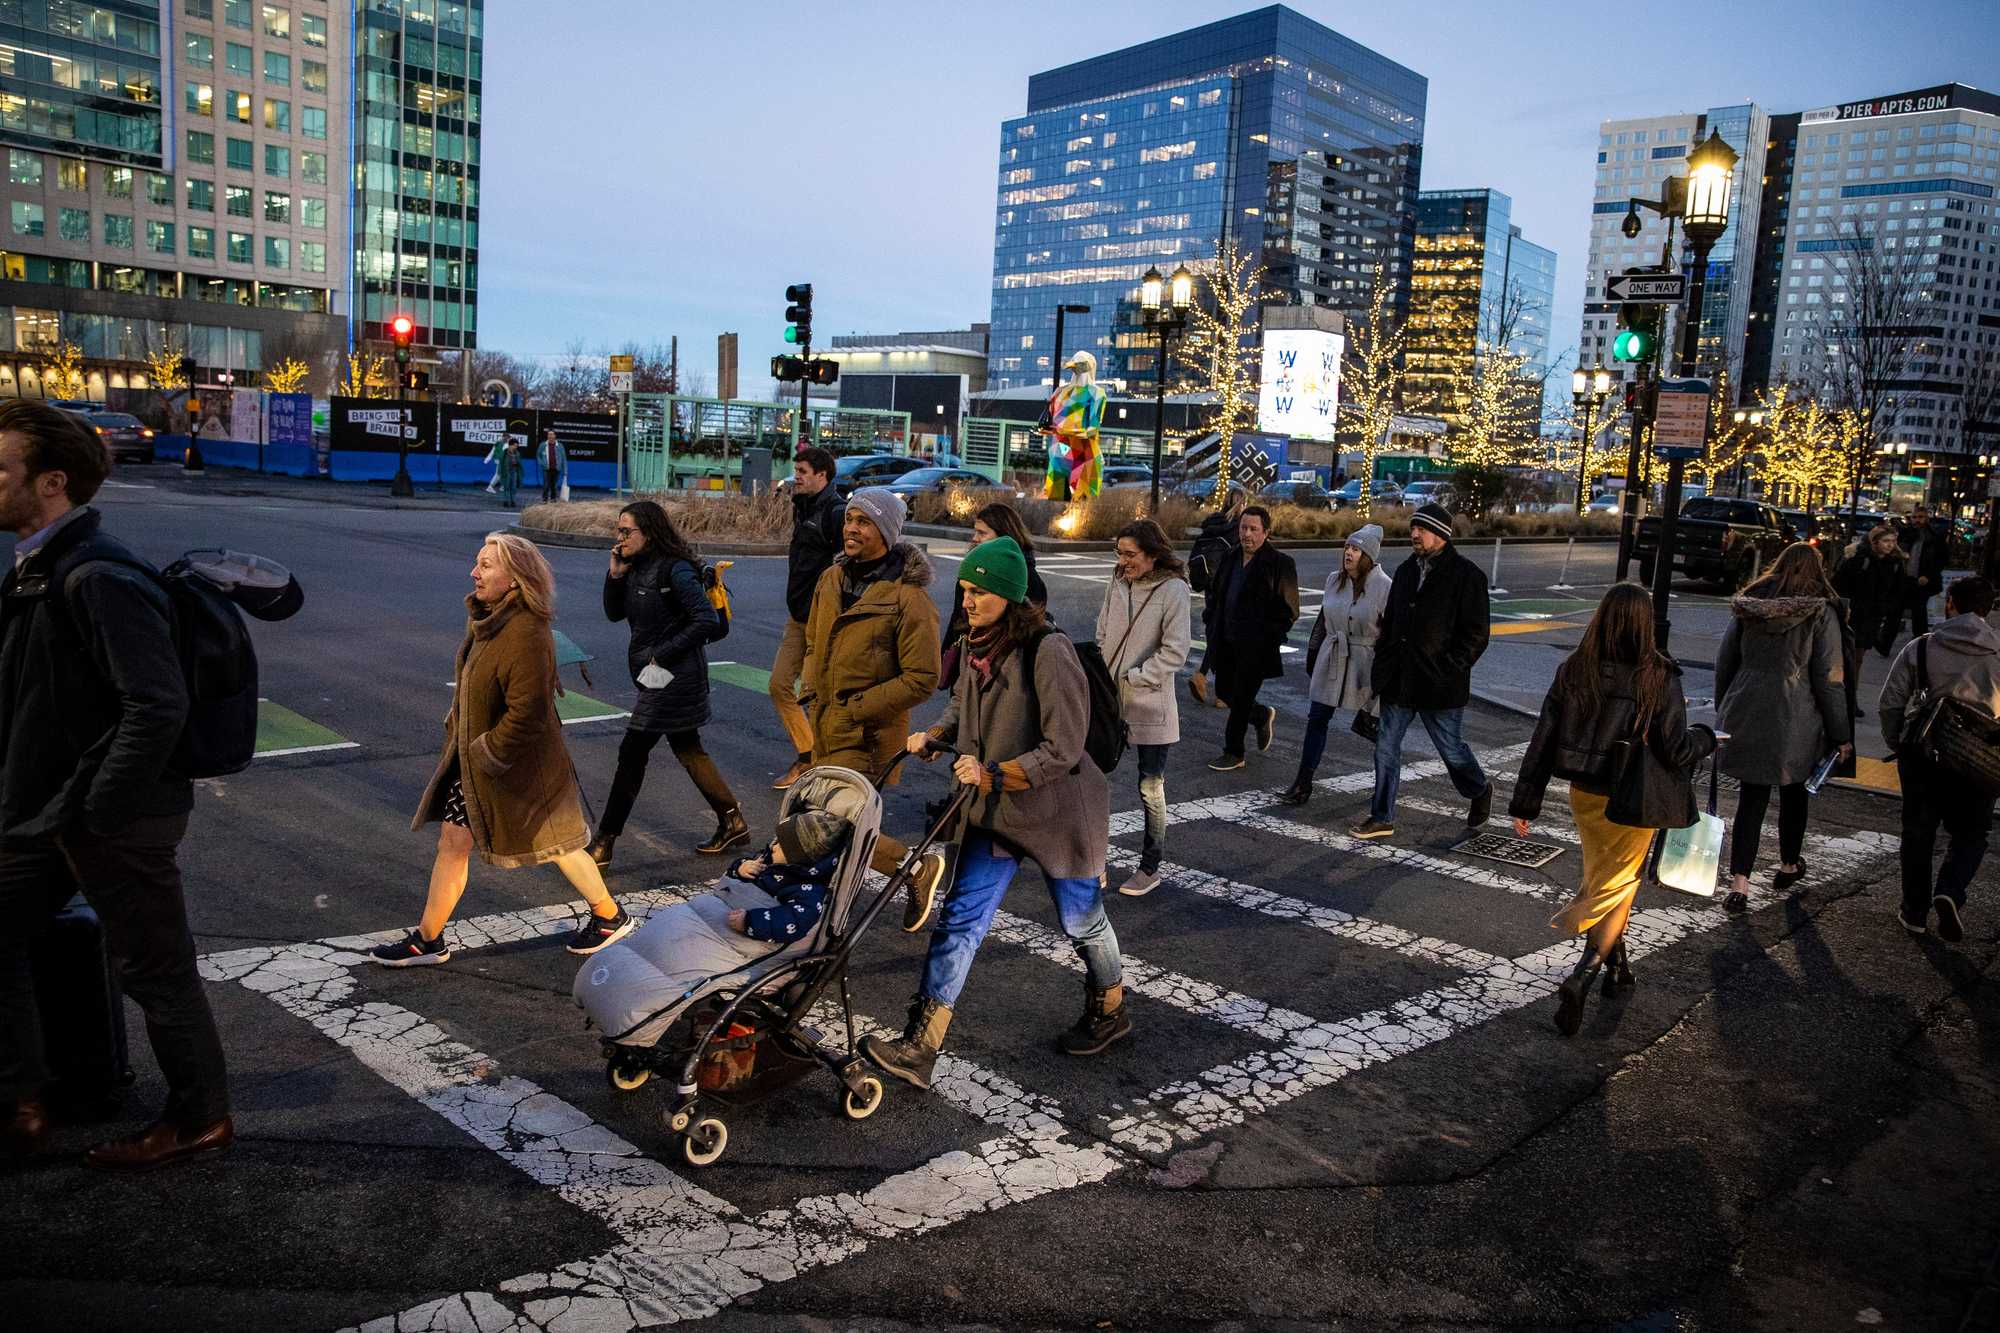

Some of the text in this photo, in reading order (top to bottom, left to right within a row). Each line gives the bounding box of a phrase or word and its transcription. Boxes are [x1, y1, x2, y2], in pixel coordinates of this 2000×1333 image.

[1629, 282, 1677, 293] ONE WAY
[351, 411, 383, 421] BRING
[370, 423, 399, 434] BRAND
[455, 421, 504, 430] THE PLACES
